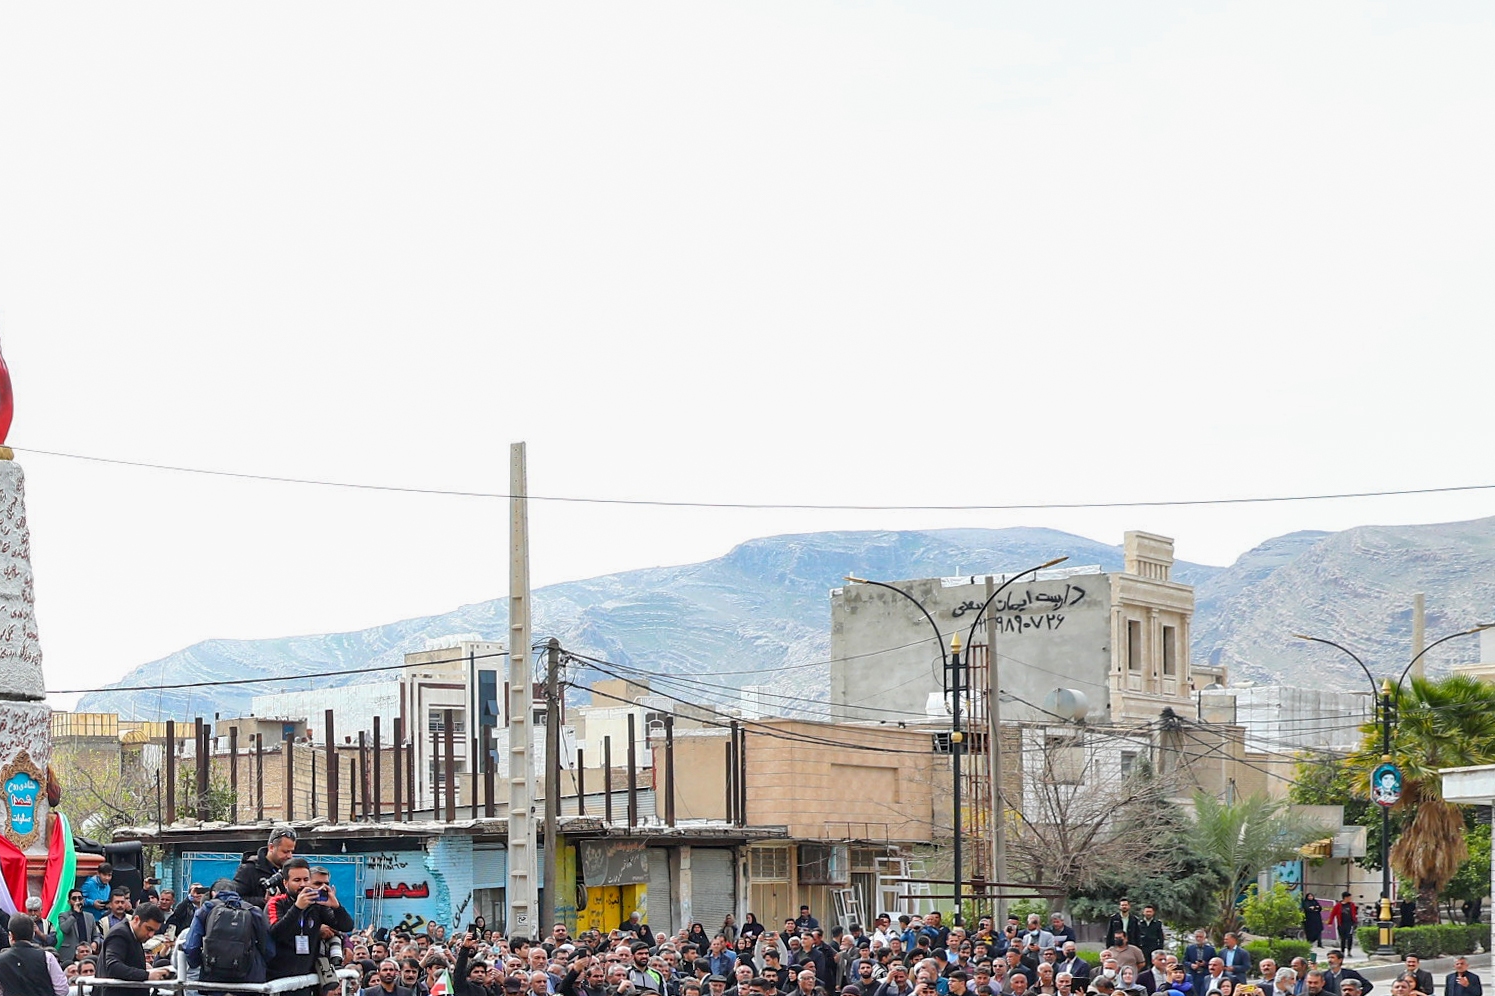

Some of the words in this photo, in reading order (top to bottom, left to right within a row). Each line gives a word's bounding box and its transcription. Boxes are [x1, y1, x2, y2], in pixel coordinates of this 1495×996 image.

[996, 590, 1032, 612] ایمان
[1036, 584, 1086, 611] داربست
[7, 782, 20, 793] روح
[19, 779, 36, 791] شادی
[11, 794, 33, 807] شهدا
[11, 813, 32, 824] صلوات
